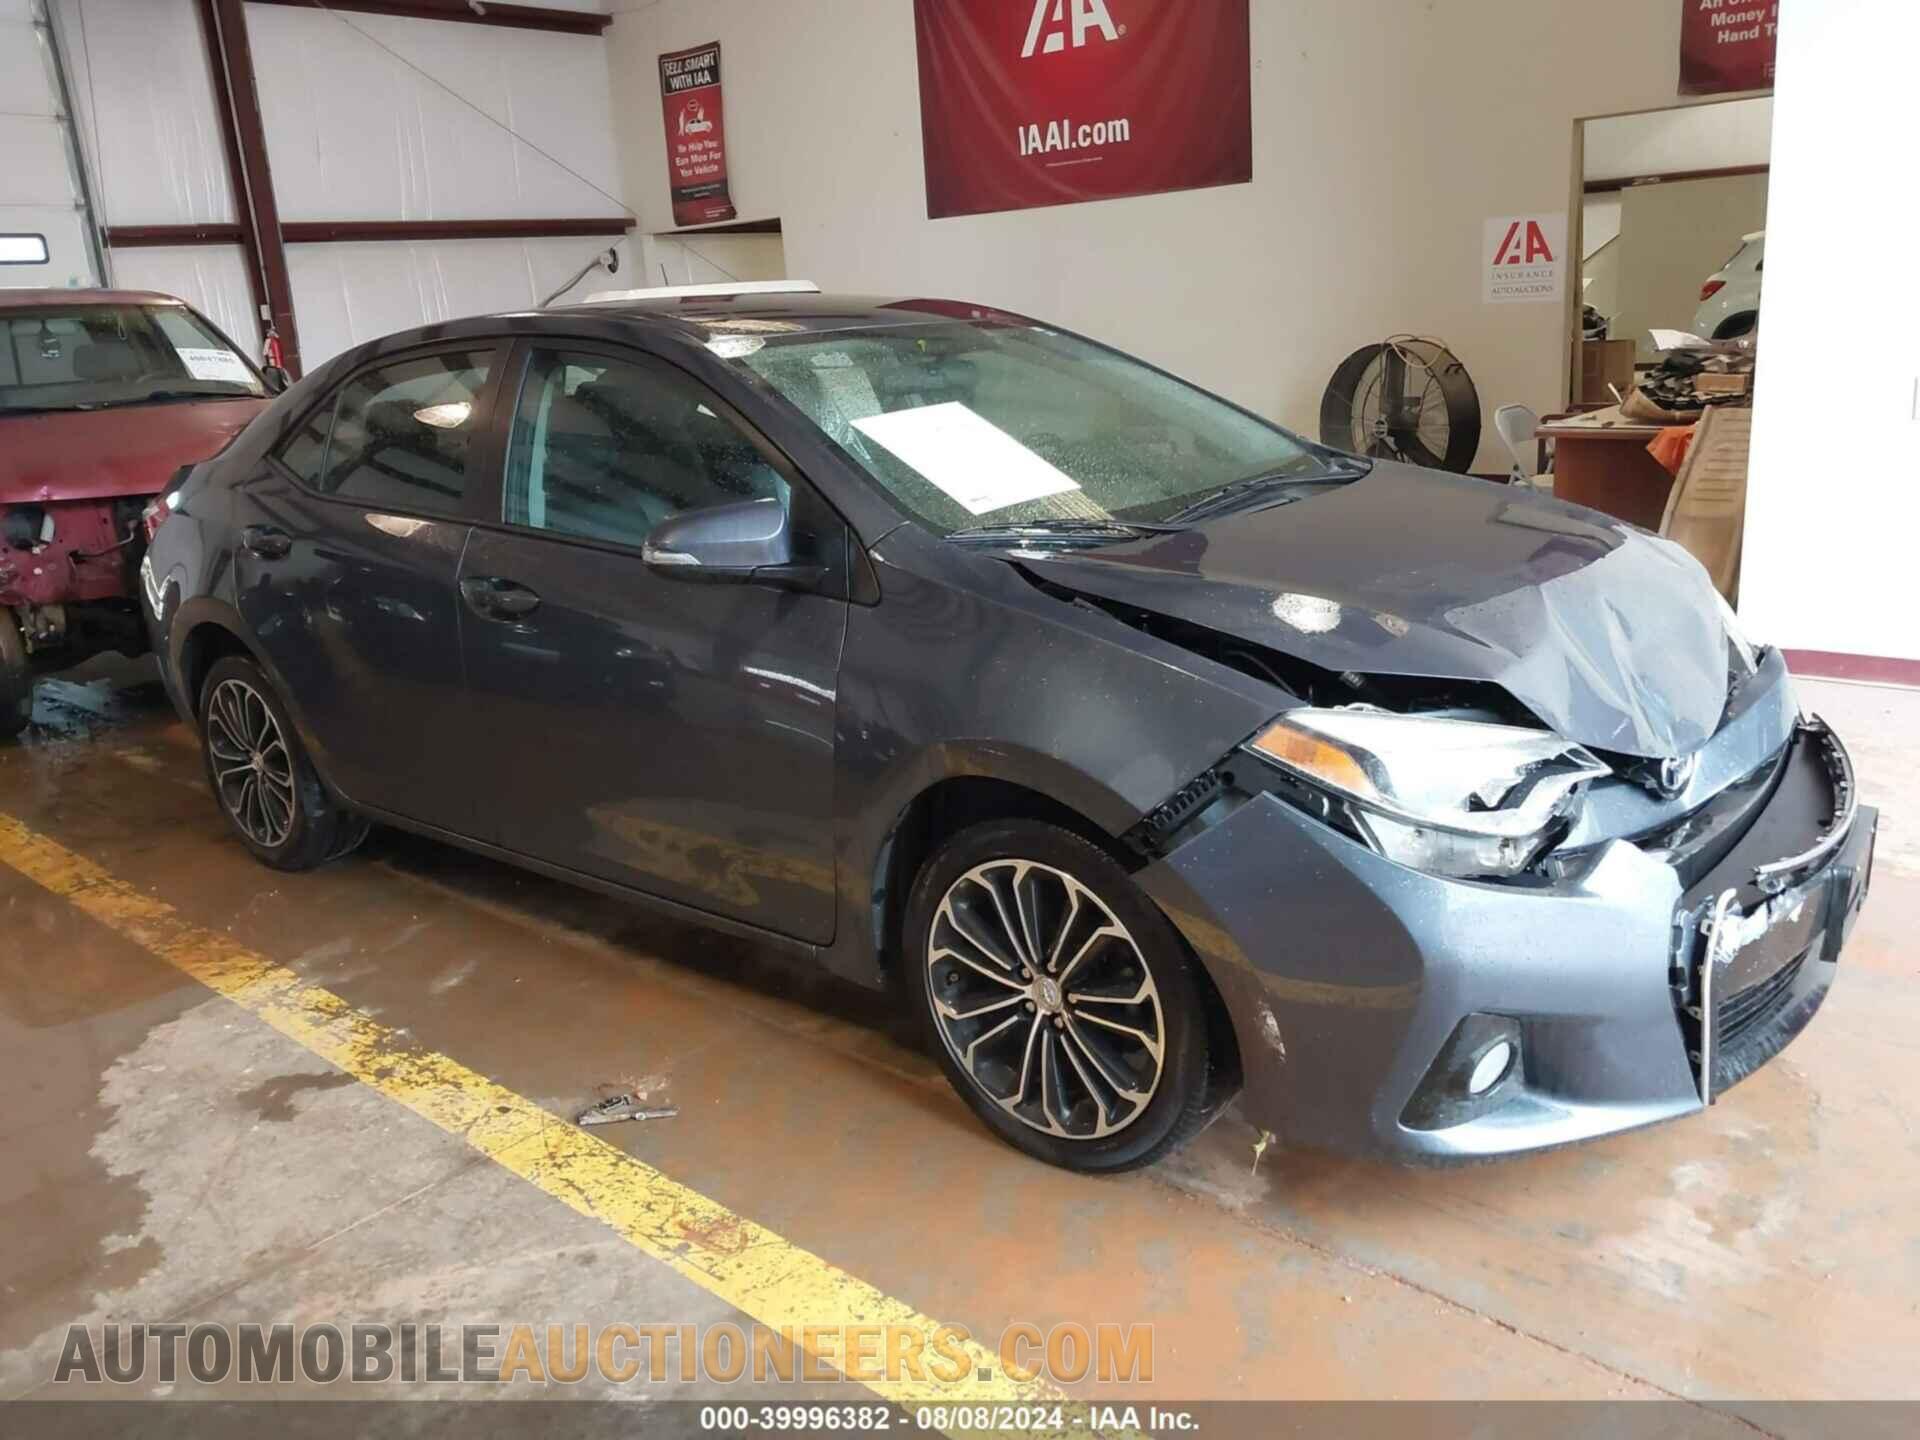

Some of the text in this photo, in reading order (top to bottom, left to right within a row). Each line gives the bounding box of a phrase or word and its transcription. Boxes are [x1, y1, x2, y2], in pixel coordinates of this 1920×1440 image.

[1711, 8, 1766, 27] Money
[1717, 25, 1760, 44] Hand
[663, 52, 716, 76] SELL SMART
[670, 69, 712, 90] WITH IAA
[1018, 118, 1130, 156] IAAI.com
